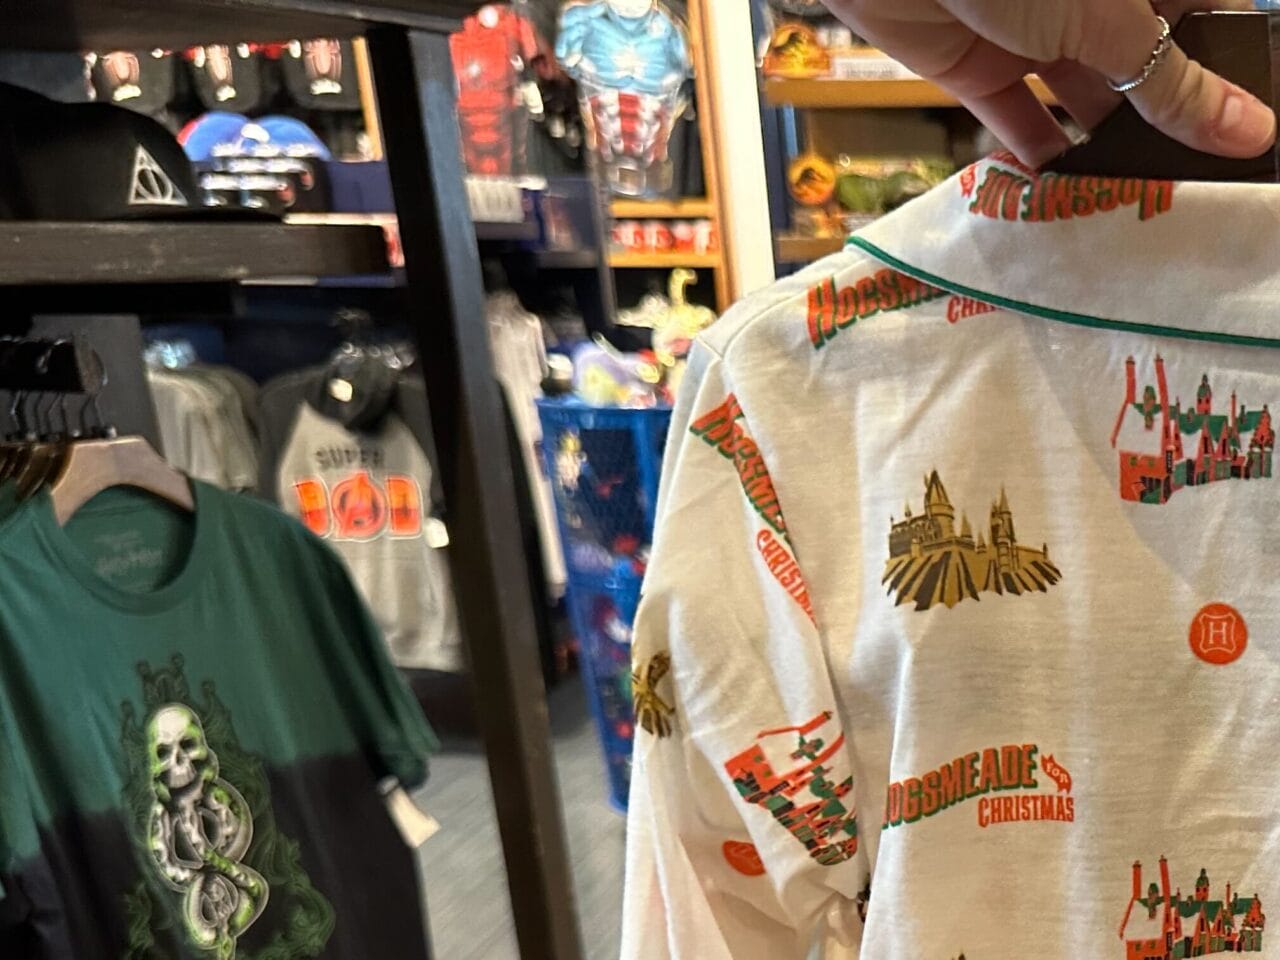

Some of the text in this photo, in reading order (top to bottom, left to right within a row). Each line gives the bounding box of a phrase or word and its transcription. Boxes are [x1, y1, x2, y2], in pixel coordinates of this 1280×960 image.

[806, 267, 950, 350] HOGSM
[882, 743, 1038, 830] OGSMEADE
[977, 794, 1075, 829] CHRISTMAS
